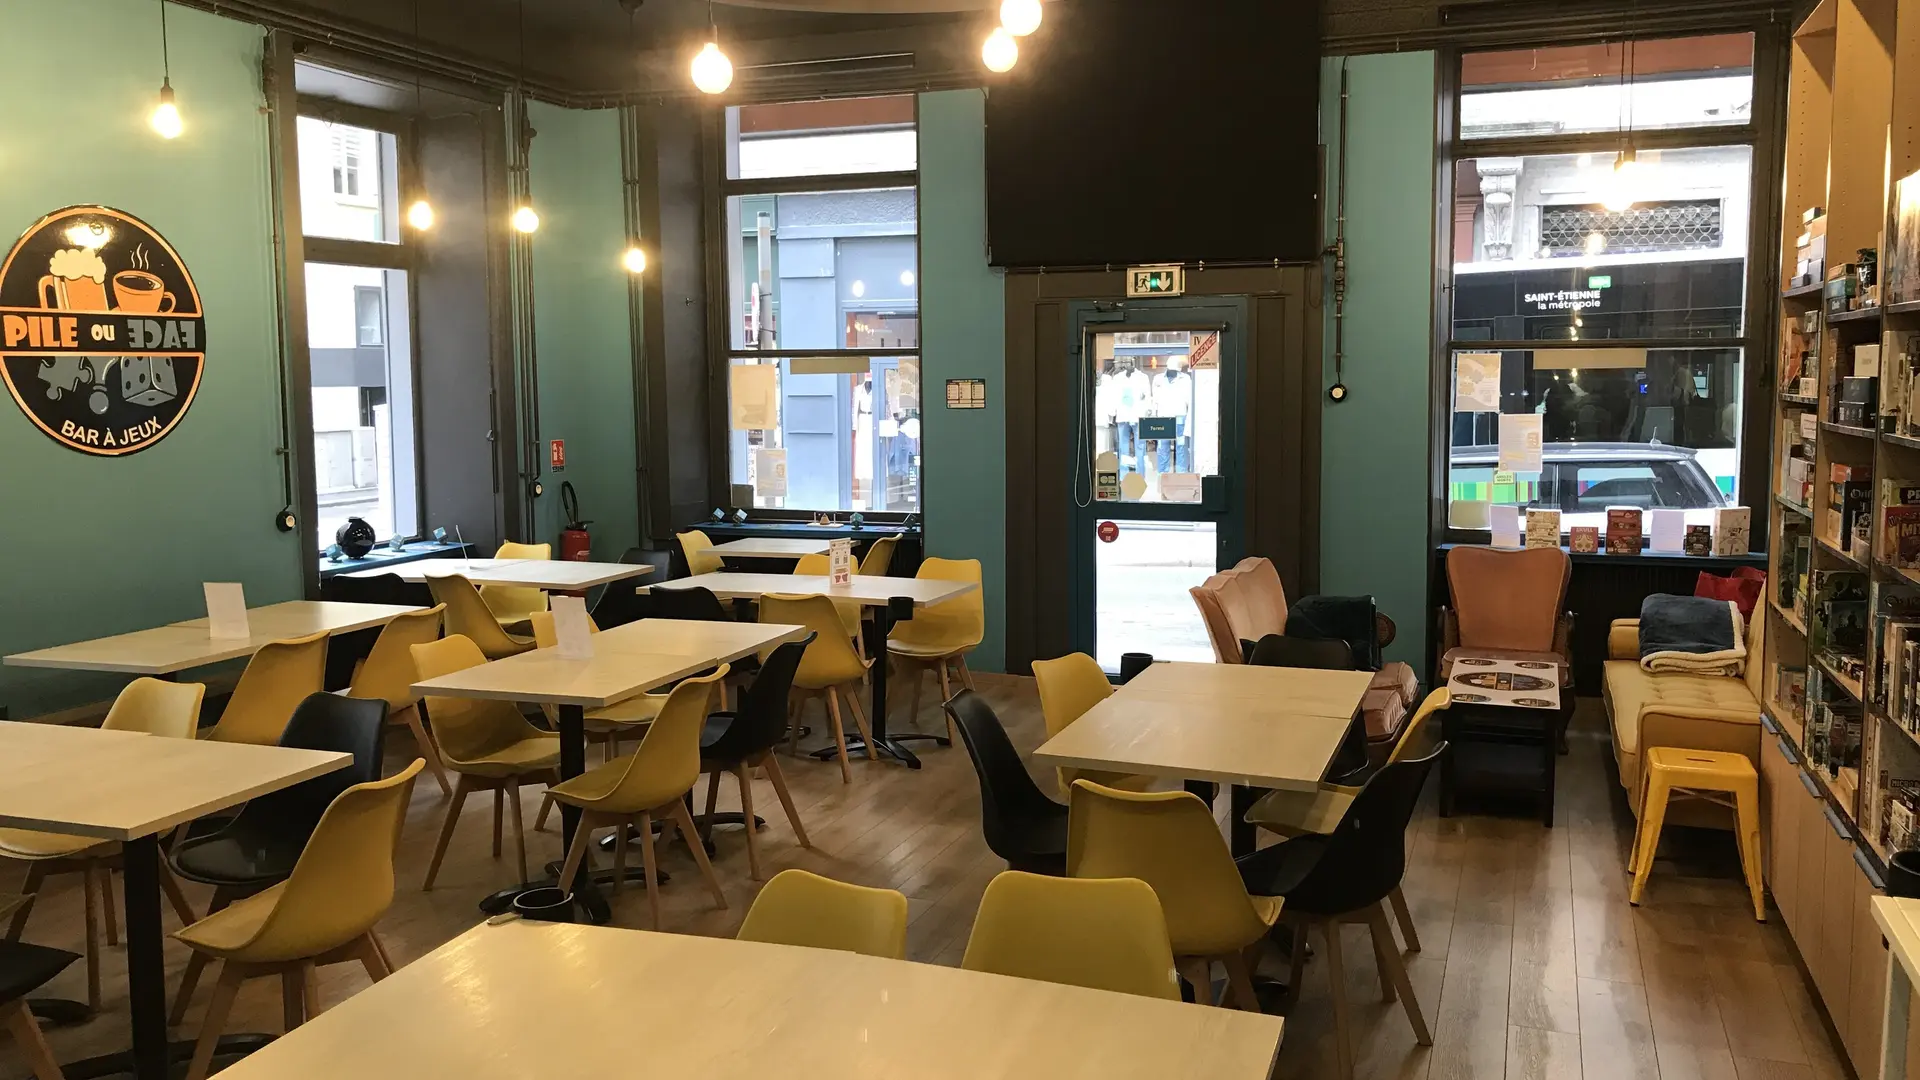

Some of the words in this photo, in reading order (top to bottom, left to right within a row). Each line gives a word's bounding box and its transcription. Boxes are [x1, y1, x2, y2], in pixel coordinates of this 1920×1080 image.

[1524, 290, 1601, 303] SAINT-ÉTIENNE
[1538, 302, 1547, 310] la
[1549, 299, 1601, 311] métropole
[3, 315, 79, 348] PILE
[1193, 336, 1202, 346] IV
[1191, 332, 1217, 366] LICENCE
[61, 419, 99, 446] BAR
[103, 427, 117, 446] À
[119, 416, 162, 446] JEUX
